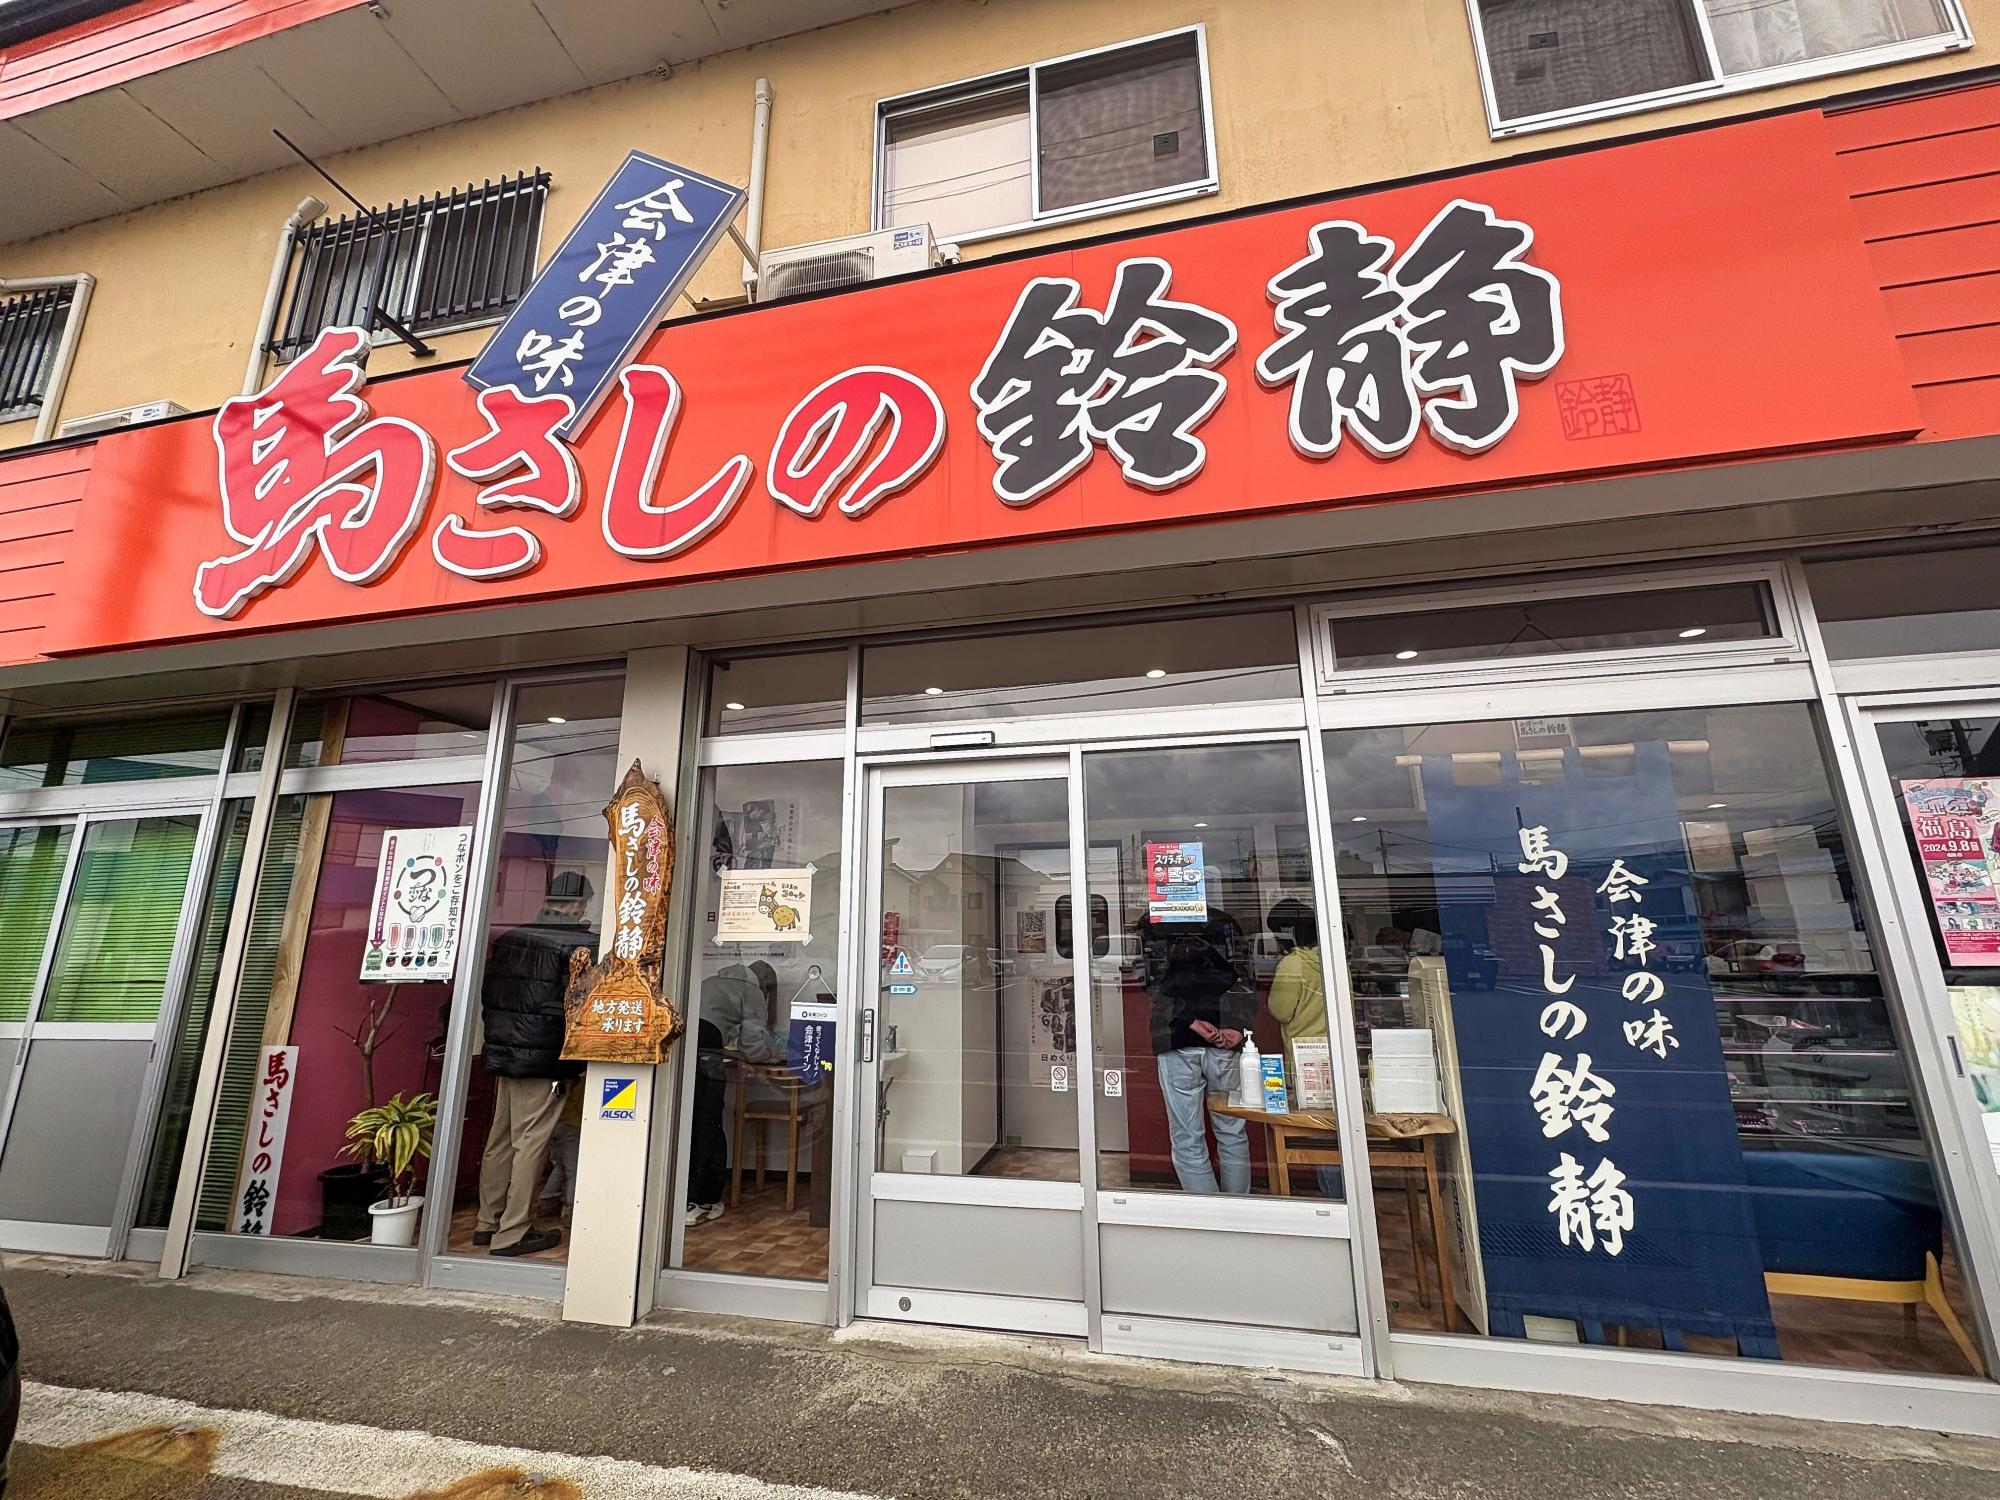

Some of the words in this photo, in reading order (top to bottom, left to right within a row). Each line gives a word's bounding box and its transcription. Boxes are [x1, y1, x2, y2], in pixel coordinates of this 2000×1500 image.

[517, 179, 695, 393] 会津の味
[192, 198, 1567, 619] 馬さしの鈴静
[642, 815, 666, 897] 会津の味
[1916, 816, 1973, 840] 福島
[614, 801, 648, 961] 馬さしの鈴静
[1597, 860, 1680, 1060] 会津の味
[591, 998, 644, 1016] 地方発送
[601, 1018, 645, 1034] 承ります
[803, 1024, 814, 1072] 会津コイン
[1517, 826, 1634, 1257] 馬さしの鈴静
[600, 1109, 635, 1119] ALSOK
